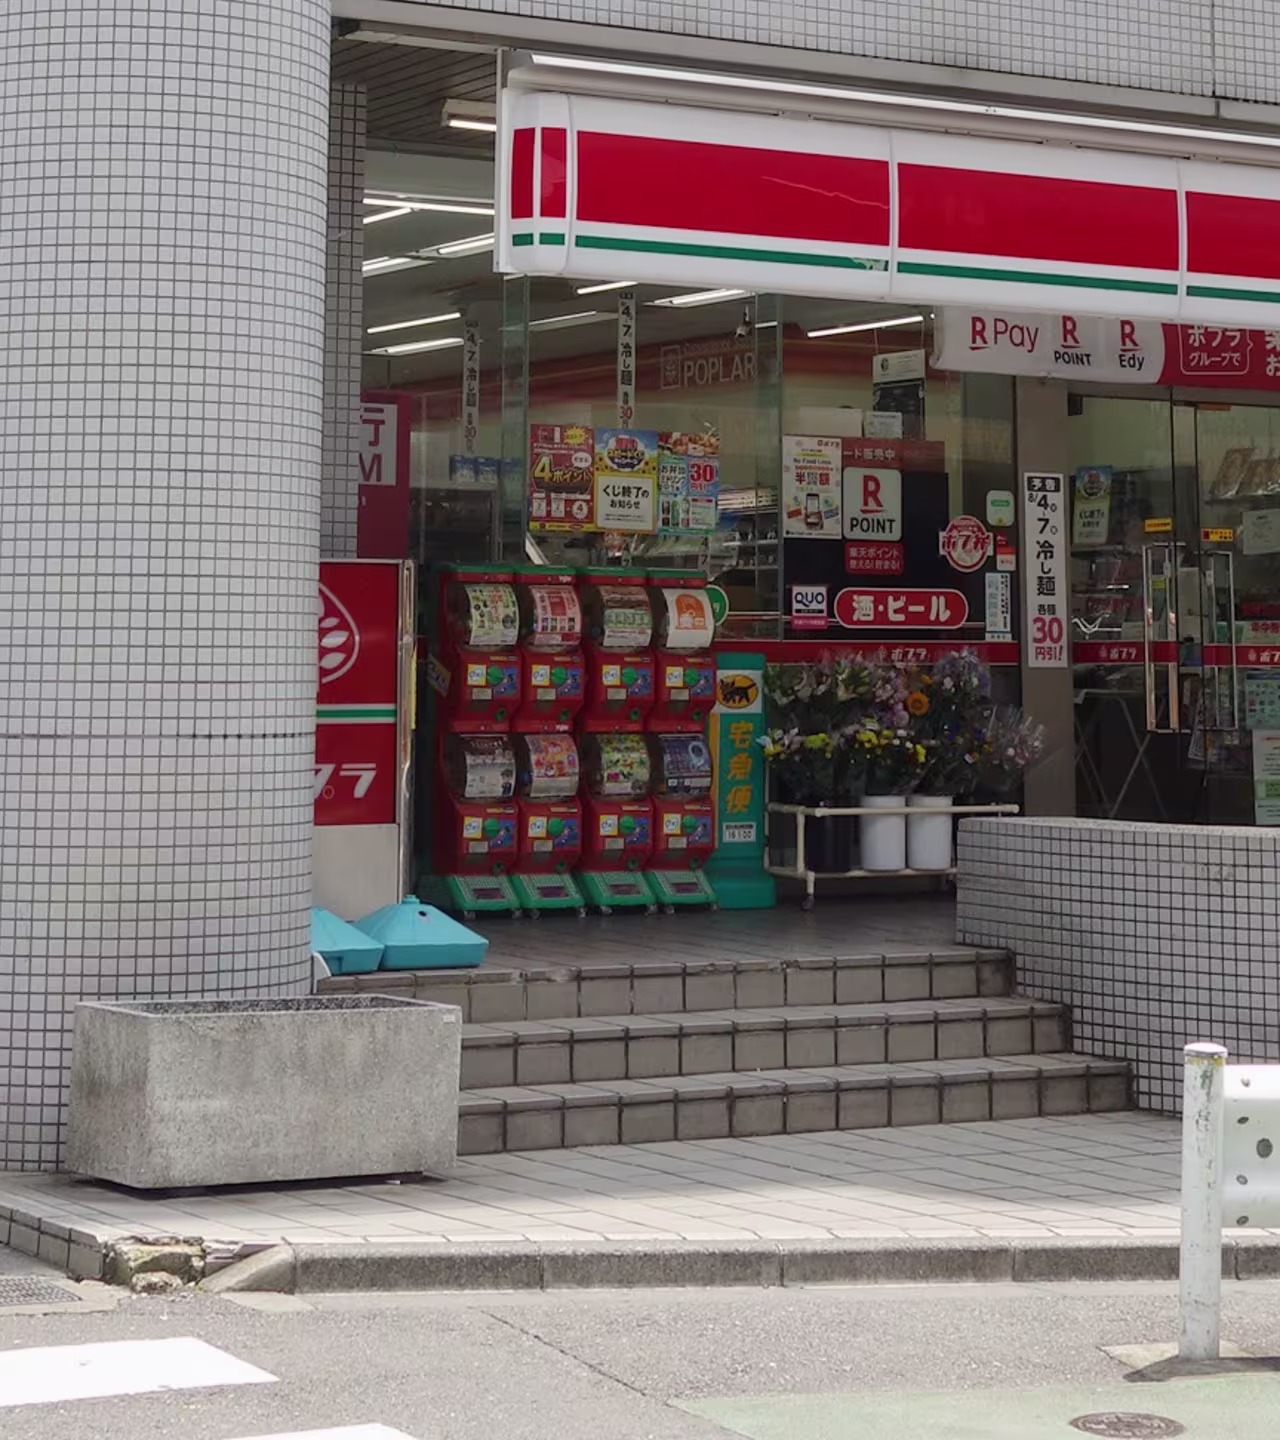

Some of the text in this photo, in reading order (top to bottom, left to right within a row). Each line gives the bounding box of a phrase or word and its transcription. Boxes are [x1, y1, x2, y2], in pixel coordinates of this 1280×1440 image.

[970, 317, 1039, 352] R Pay
[1061, 316, 1081, 347] R
[1120, 320, 1140, 351] R
[684, 352, 757, 387] POPLAR
[1054, 351, 1091, 366] POINT
[1119, 354, 1145, 371] Edy
[1188, 351, 1241, 367] グループで
[690, 463, 714, 482] 30
[603, 485, 650, 499] くじ終了の
[610, 500, 641, 509] お知らせ
[861, 475, 884, 513] R
[850, 518, 896, 534] POINT
[1036, 540, 1056, 596] 冷し麺
[794, 592, 824, 607] QUO
[852, 594, 951, 622] 酒・ビール
[1033, 617, 1063, 644] 30
[726, 721, 754, 814] 宅急便
